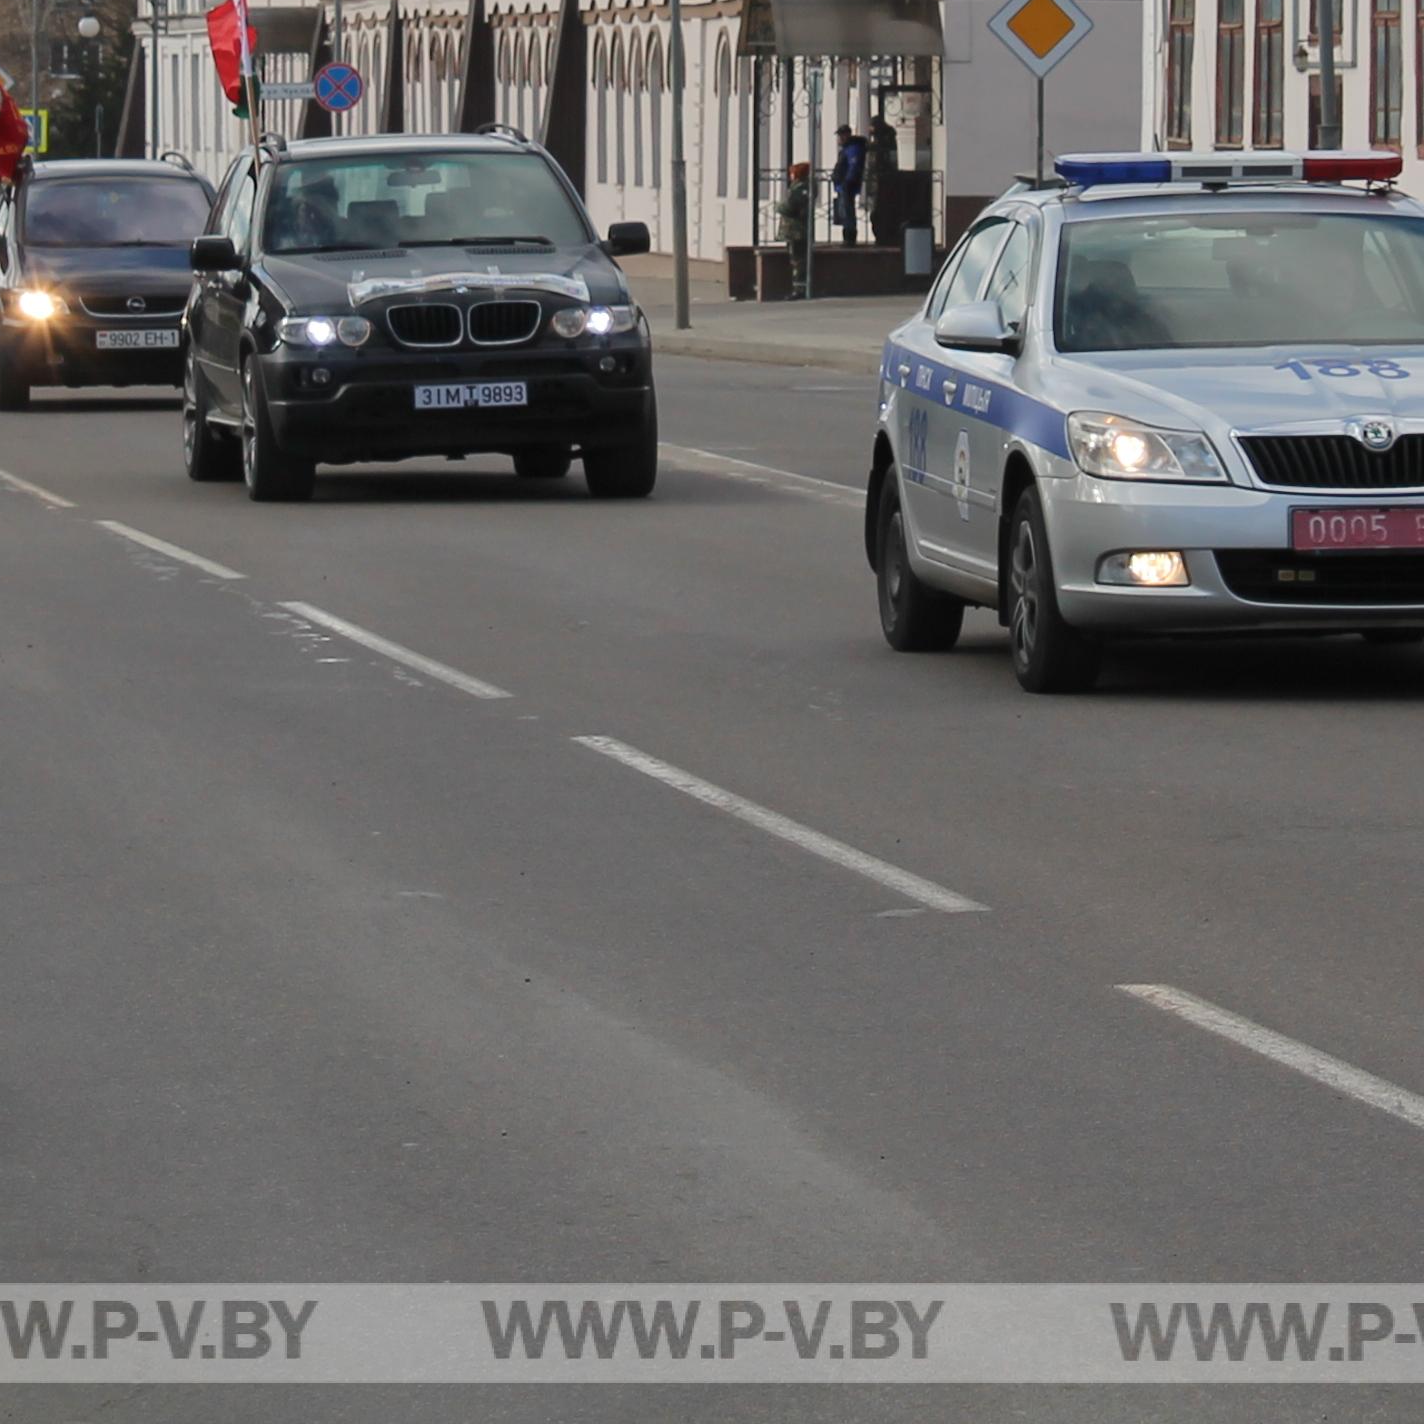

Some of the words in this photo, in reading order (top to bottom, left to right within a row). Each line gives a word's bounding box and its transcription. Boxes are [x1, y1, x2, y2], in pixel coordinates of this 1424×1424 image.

[109, 331, 141, 347] 9902
[1274, 358, 1411, 381] 188
[1309, 515, 1388, 543] 0005
